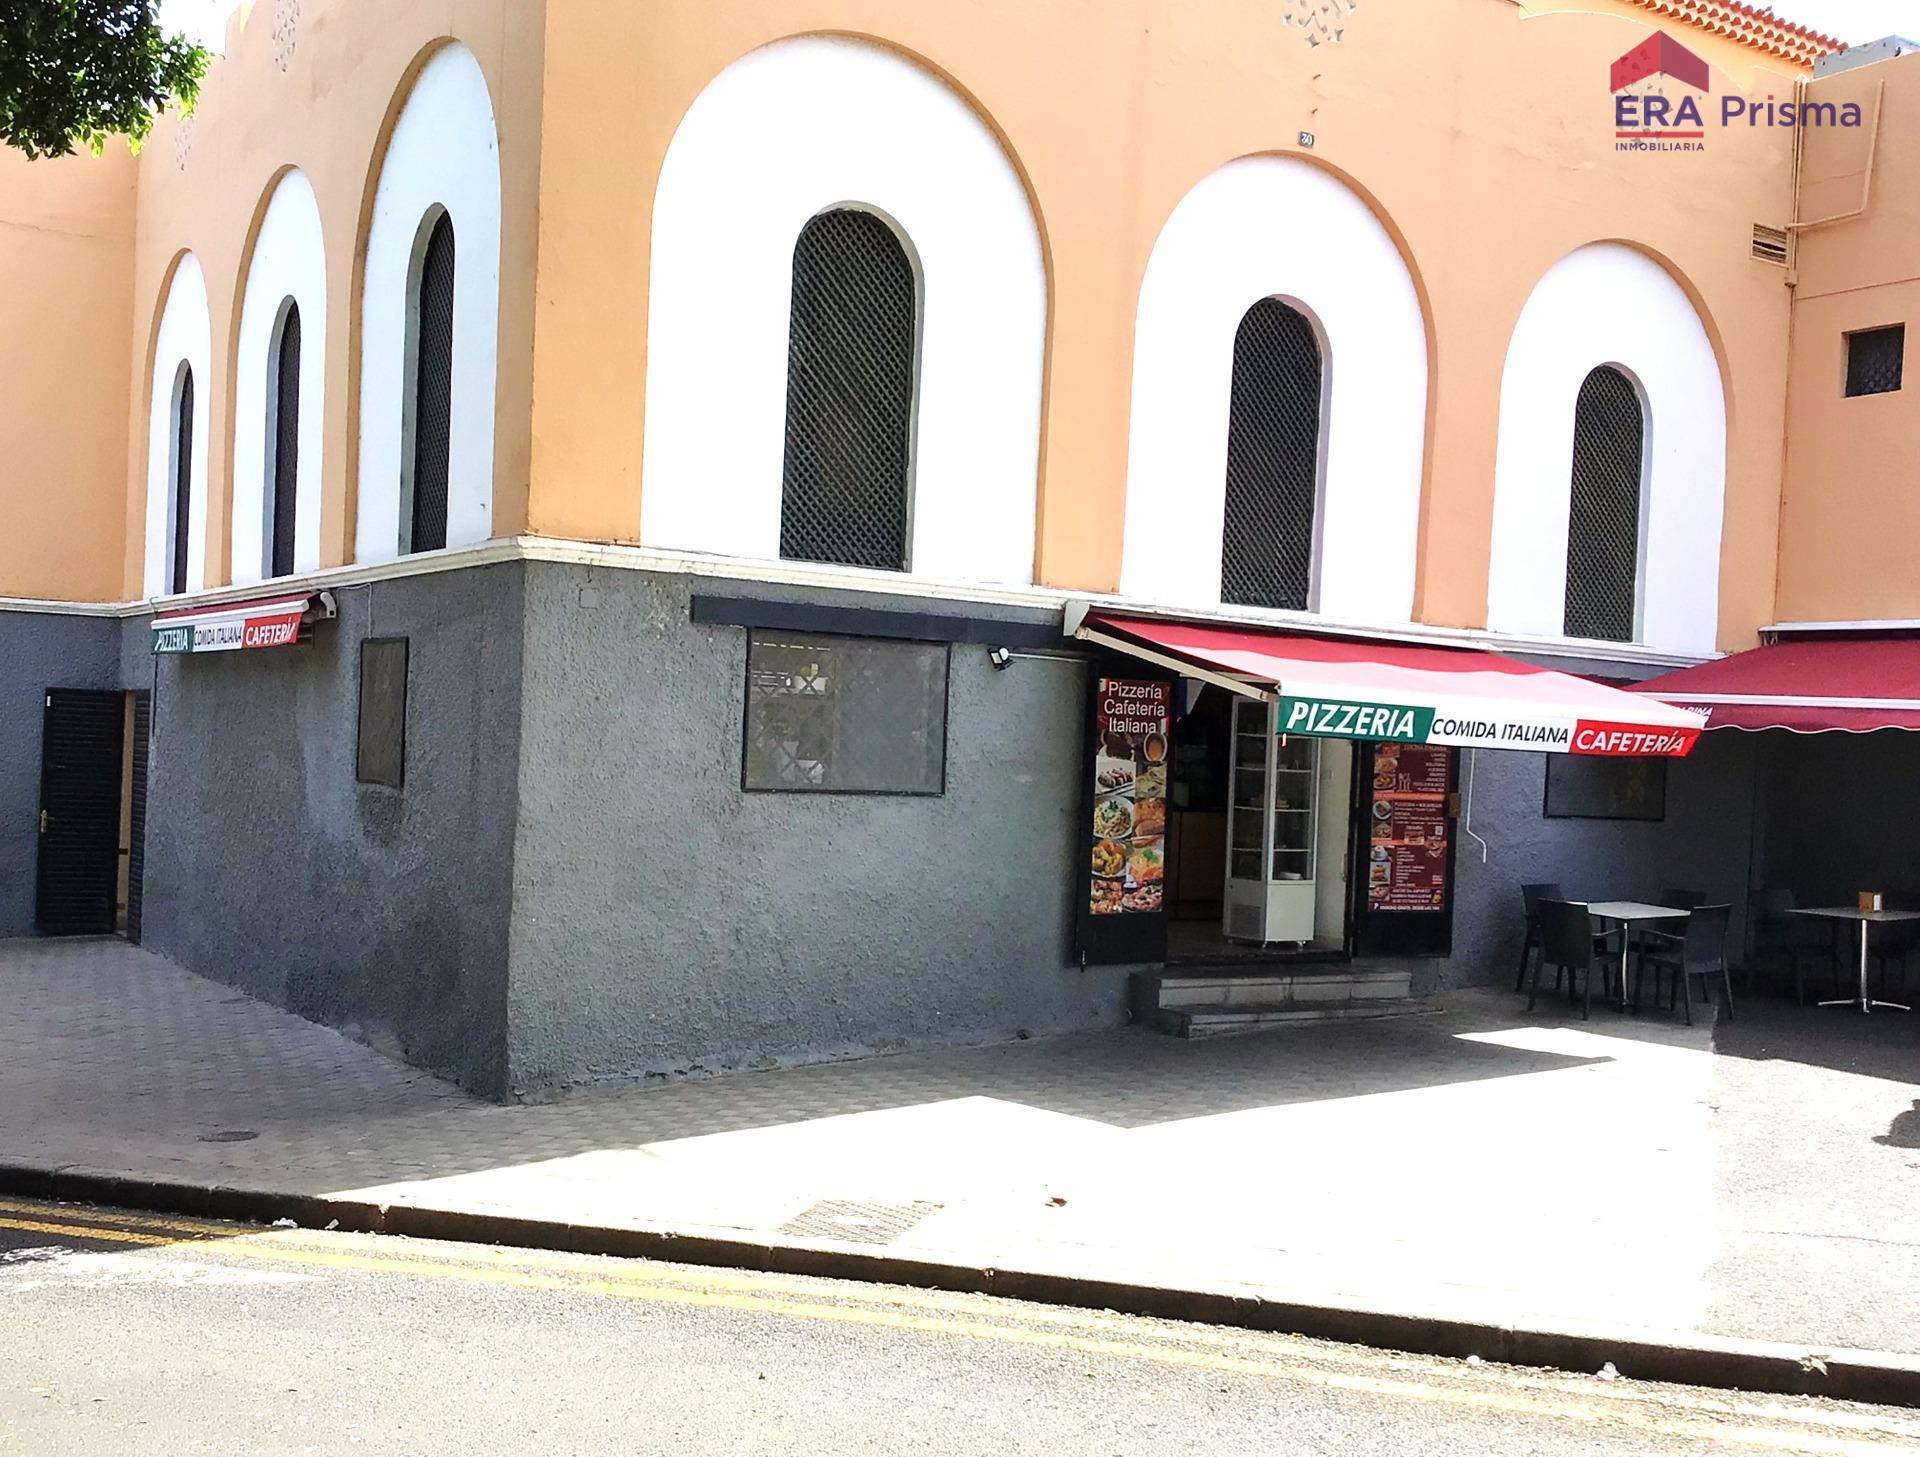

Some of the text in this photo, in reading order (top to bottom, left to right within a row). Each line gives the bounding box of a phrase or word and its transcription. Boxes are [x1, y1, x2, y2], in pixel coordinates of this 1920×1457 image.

[154, 628, 189, 652] PIZZERIA
[194, 628, 215, 646] COMIDA
[216, 625, 242, 644] ITALIANA
[1108, 681, 1162, 699] Pizzería
[1104, 699, 1165, 716] Cafetería
[1109, 717, 1156, 733] Italiana
[1286, 701, 1686, 753] PIZZERIA COMIDA ITALIANA CAFETERÍA
